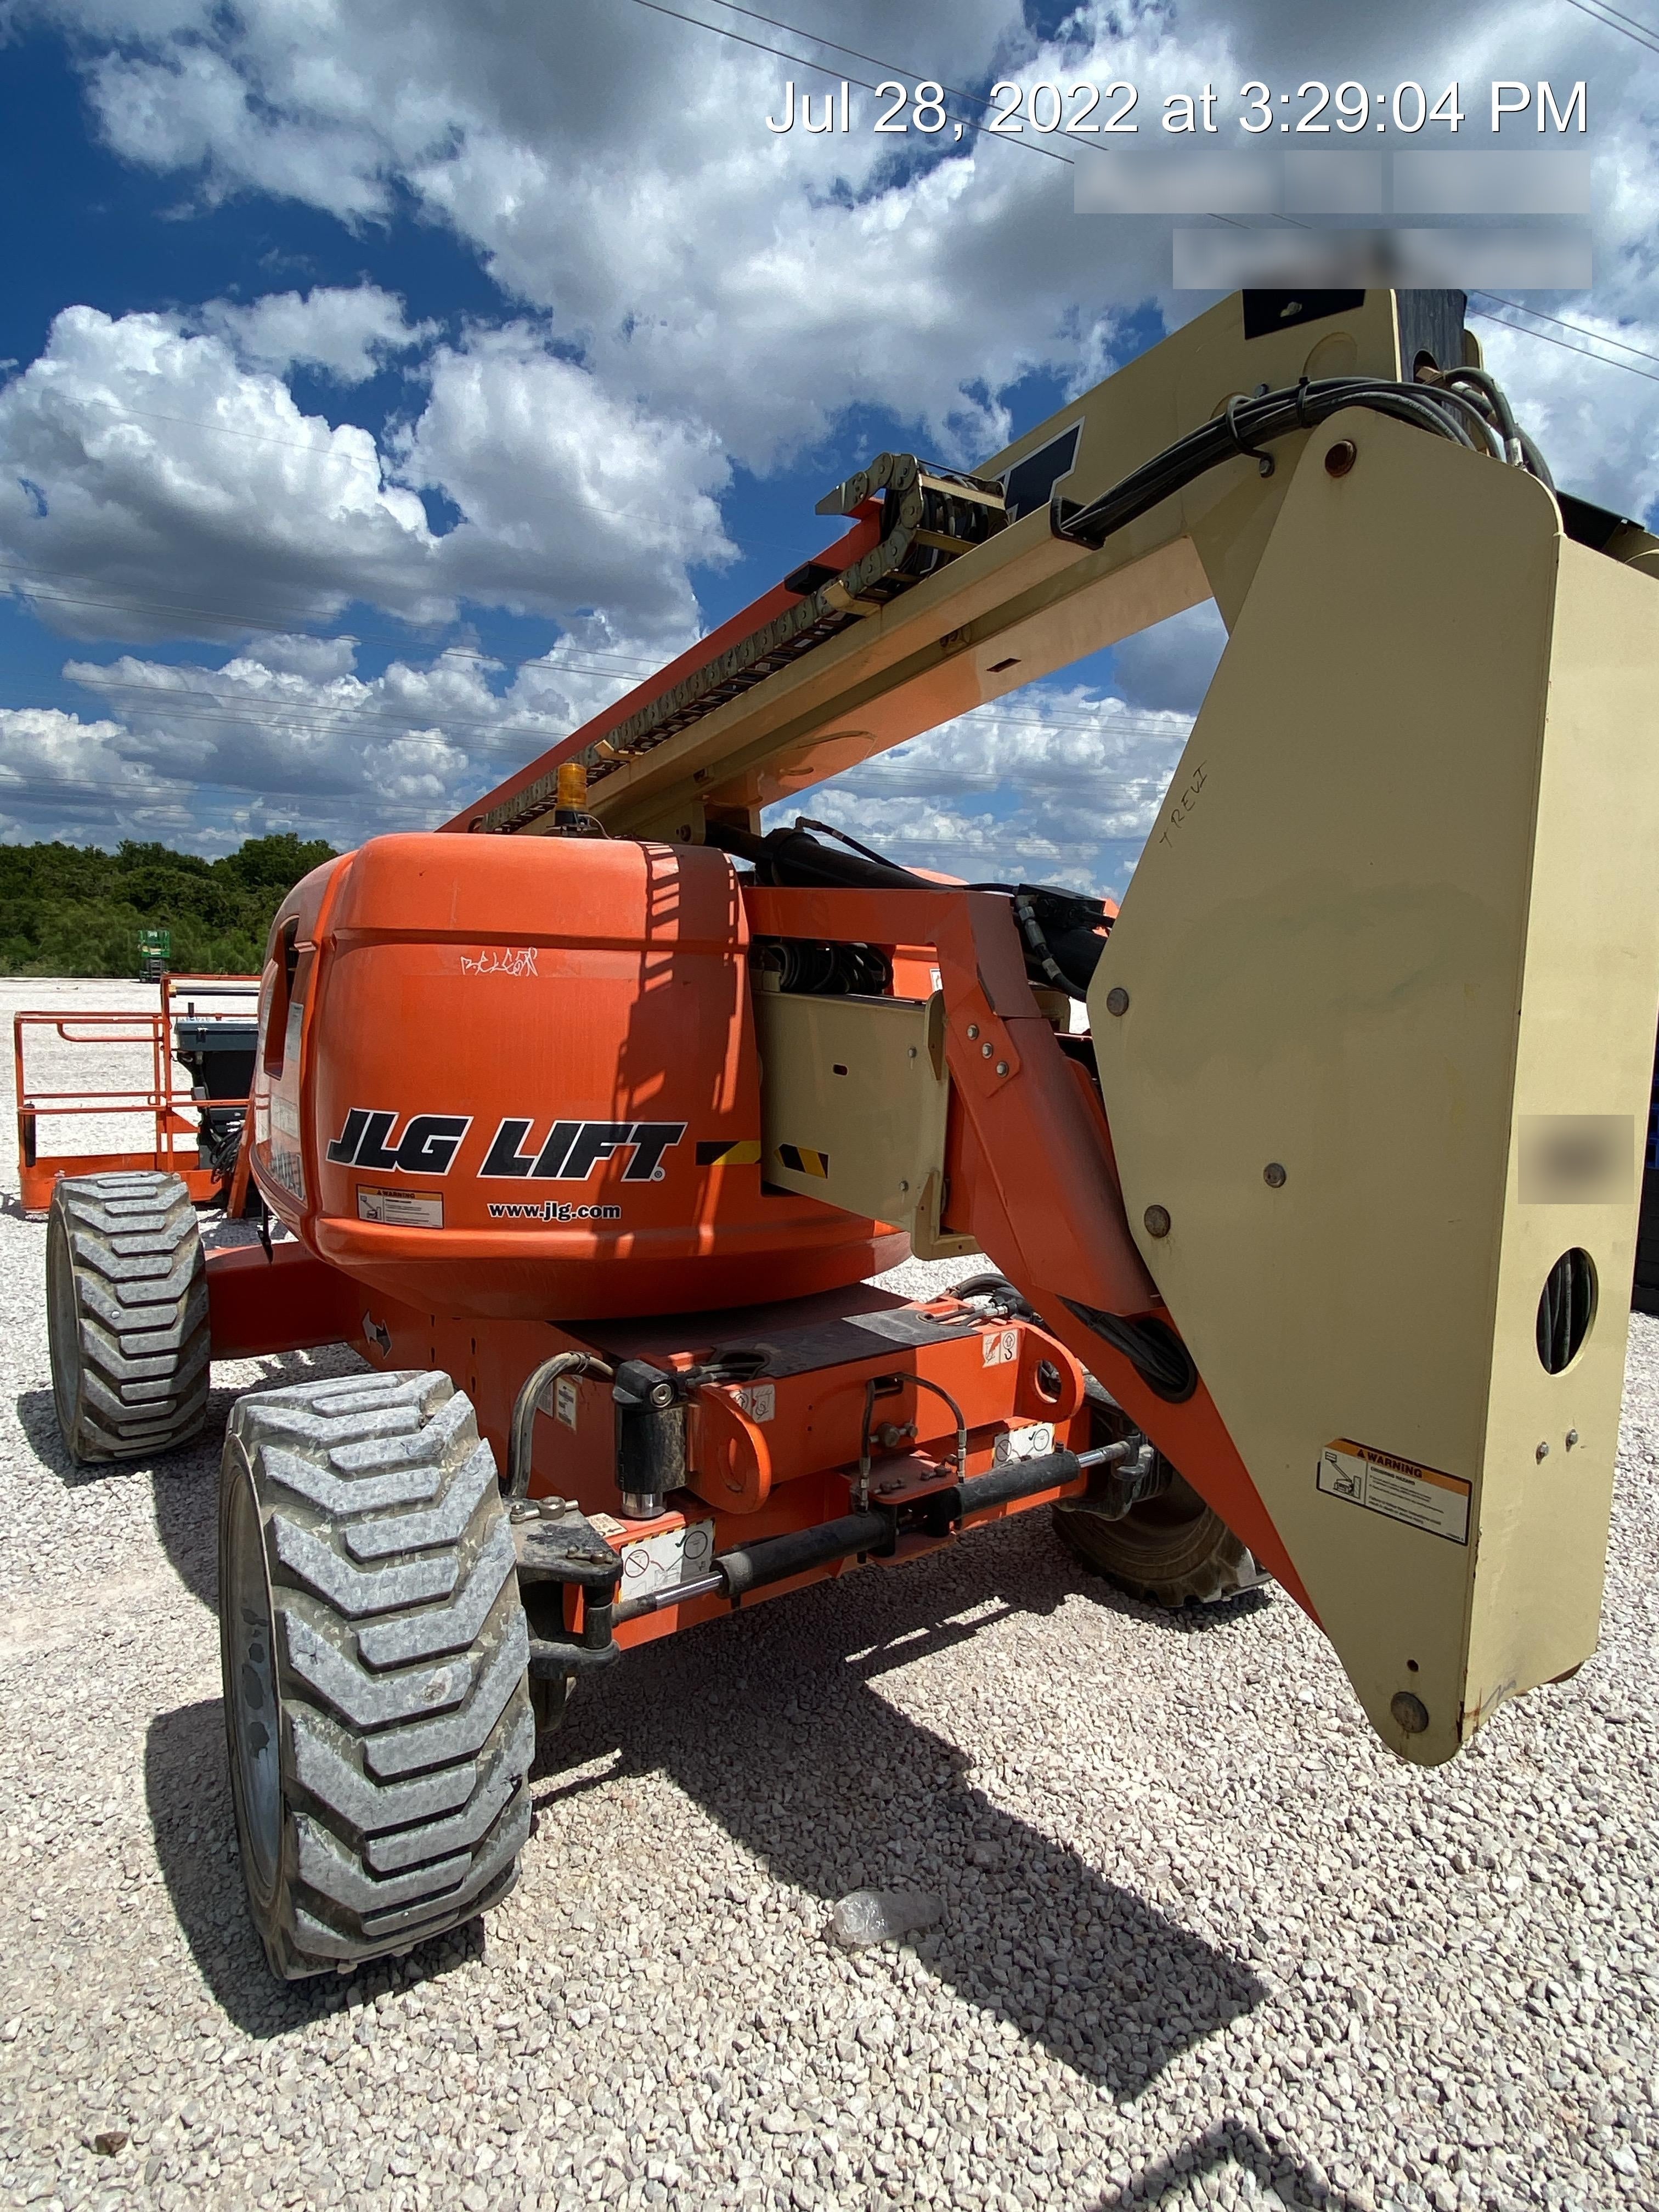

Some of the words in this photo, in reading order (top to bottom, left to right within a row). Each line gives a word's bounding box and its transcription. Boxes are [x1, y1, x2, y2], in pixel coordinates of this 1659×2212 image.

[326, 1107, 474, 1176] JLG
[383, 1190, 416, 1199] WARNING
[488, 1201, 622, 1222] www.jlg.com
[1367, 1451, 1423, 1479] WARNING
